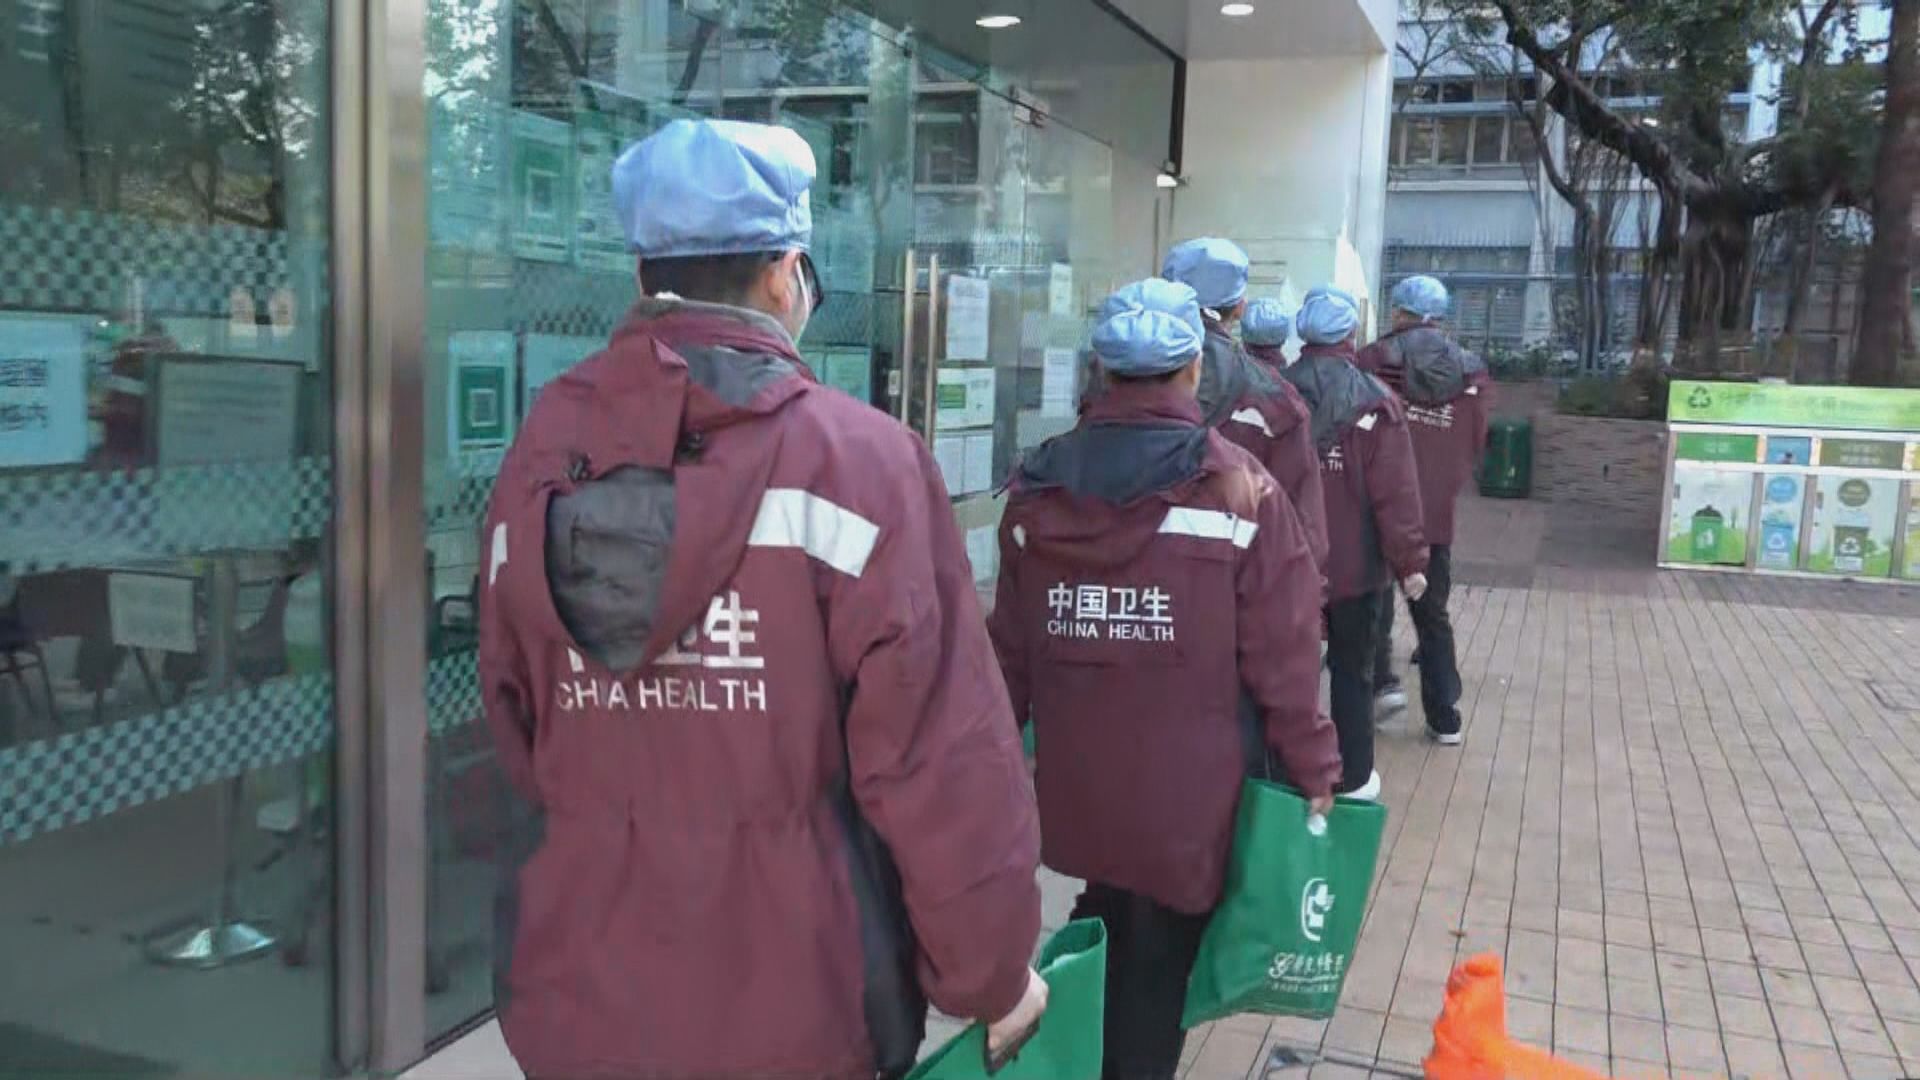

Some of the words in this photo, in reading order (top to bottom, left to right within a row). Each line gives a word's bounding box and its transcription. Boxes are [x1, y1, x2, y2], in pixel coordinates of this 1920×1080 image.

[1048, 582, 1173, 622] 中国卫生
[1047, 620, 1099, 639] CHINA
[1109, 624, 1174, 641] HEALTH
[639, 677, 766, 711] HEALTH
